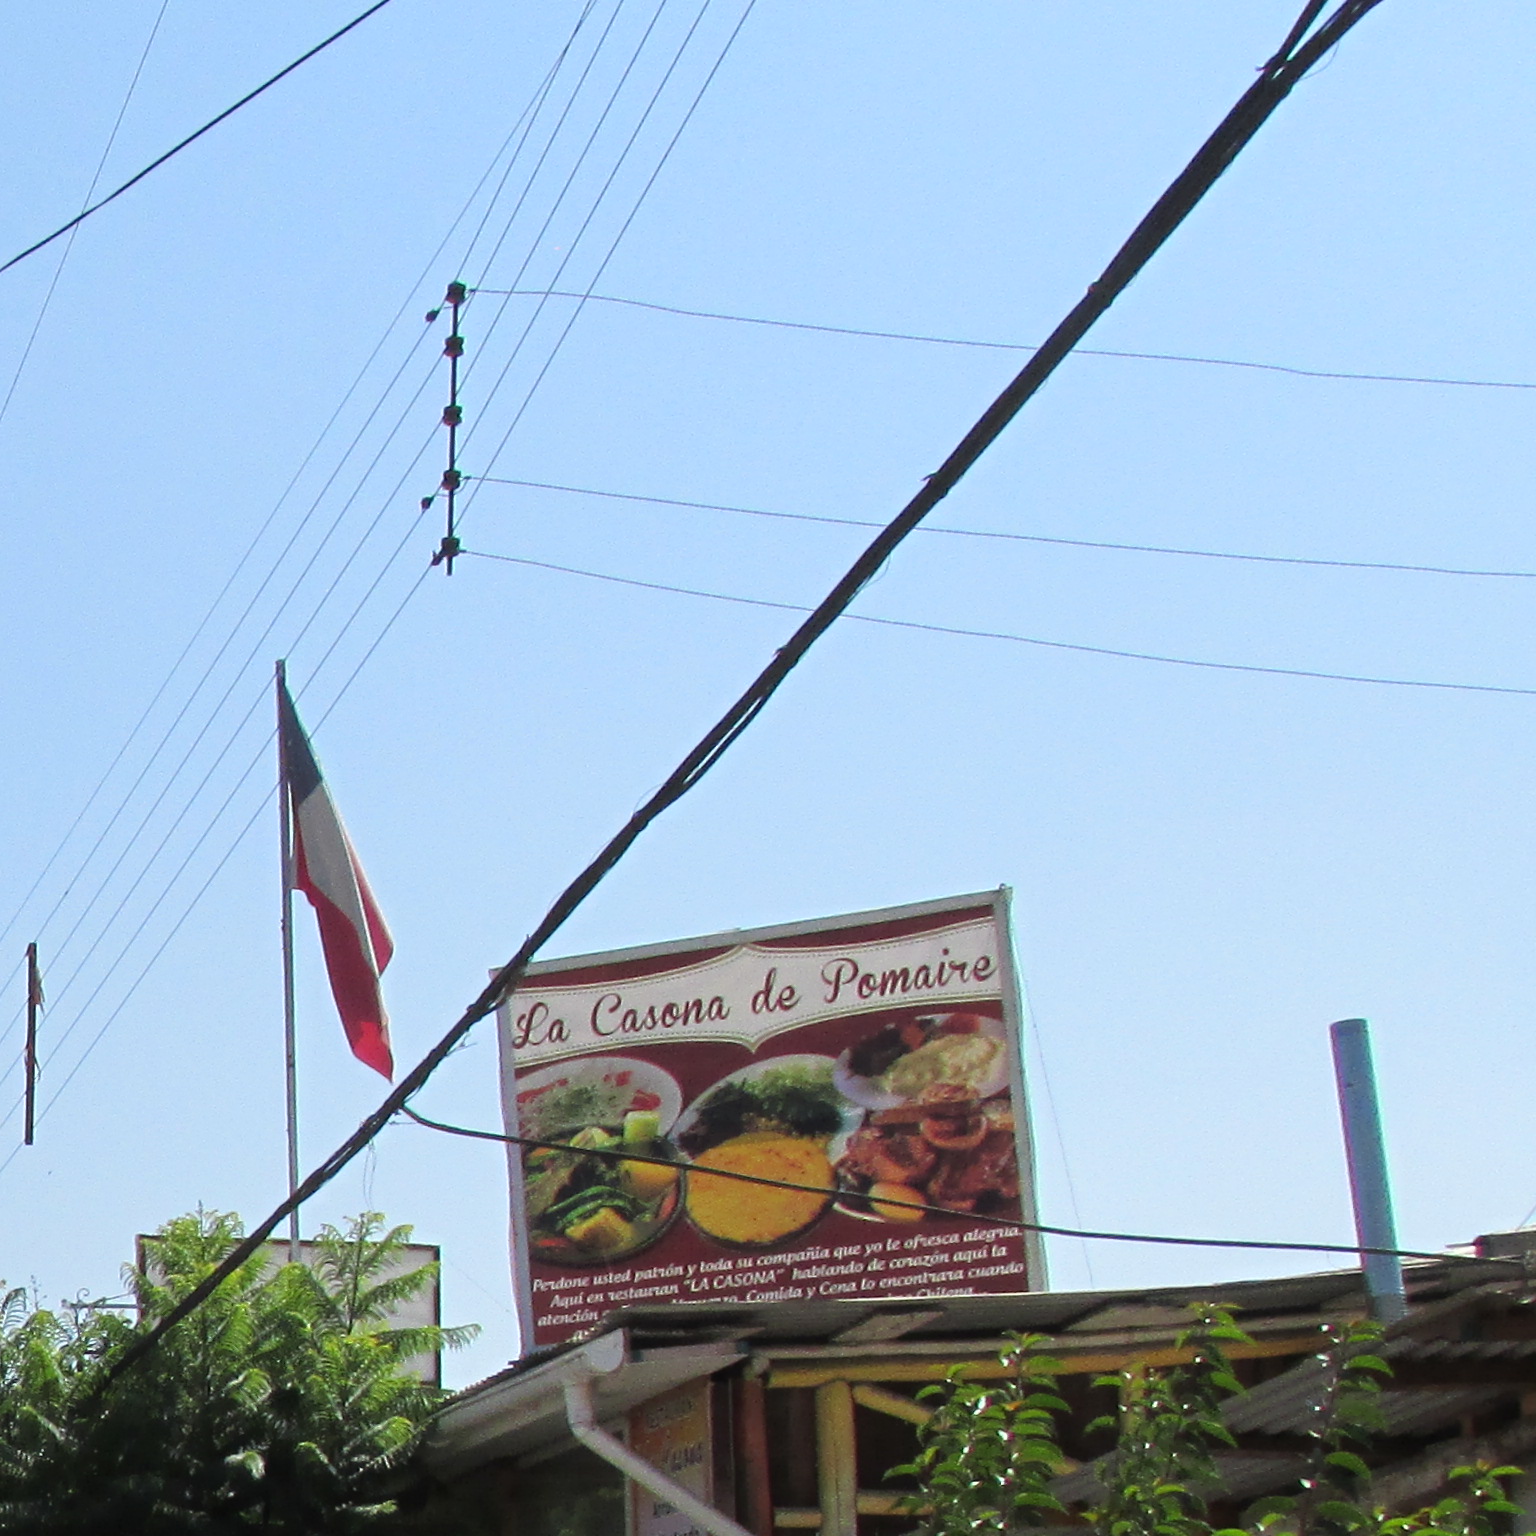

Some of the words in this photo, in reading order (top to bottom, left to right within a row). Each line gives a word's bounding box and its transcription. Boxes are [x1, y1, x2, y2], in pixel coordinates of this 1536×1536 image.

[512, 1001, 570, 1050] La
[590, 993, 731, 1038] Casona
[751, 967, 801, 1015] de
[820, 947, 999, 1004] Pomaire
[532, 1276, 590, 1292] Perdone
[592, 1270, 630, 1285] usted
[634, 1262, 683, 1282] patrón
[686, 1263, 697, 1277] y
[699, 1257, 733, 1273] toda
[736, 1257, 753, 1269] su
[833, 1243, 861, 1259] que
[863, 1241, 883, 1257] yo
[885, 1237, 900, 1252] le
[537, 1308, 599, 1327] atención
[746, 1286, 803, 1302] Comida
[806, 1287, 816, 1299] y
[819, 1280, 858, 1295] Cena
[861, 1277, 876, 1290] lo
[967, 1261, 1025, 1279] cuando
[549, 1291, 585, 1309] Aquí
[587, 1292, 605, 1304] en
[792, 1261, 864, 1280] hablando
[867, 1257, 886, 1272] de
[889, 1250, 949, 1269] corazón
[952, 1243, 988, 1263] aquí
[991, 1244, 1008, 1257] la
